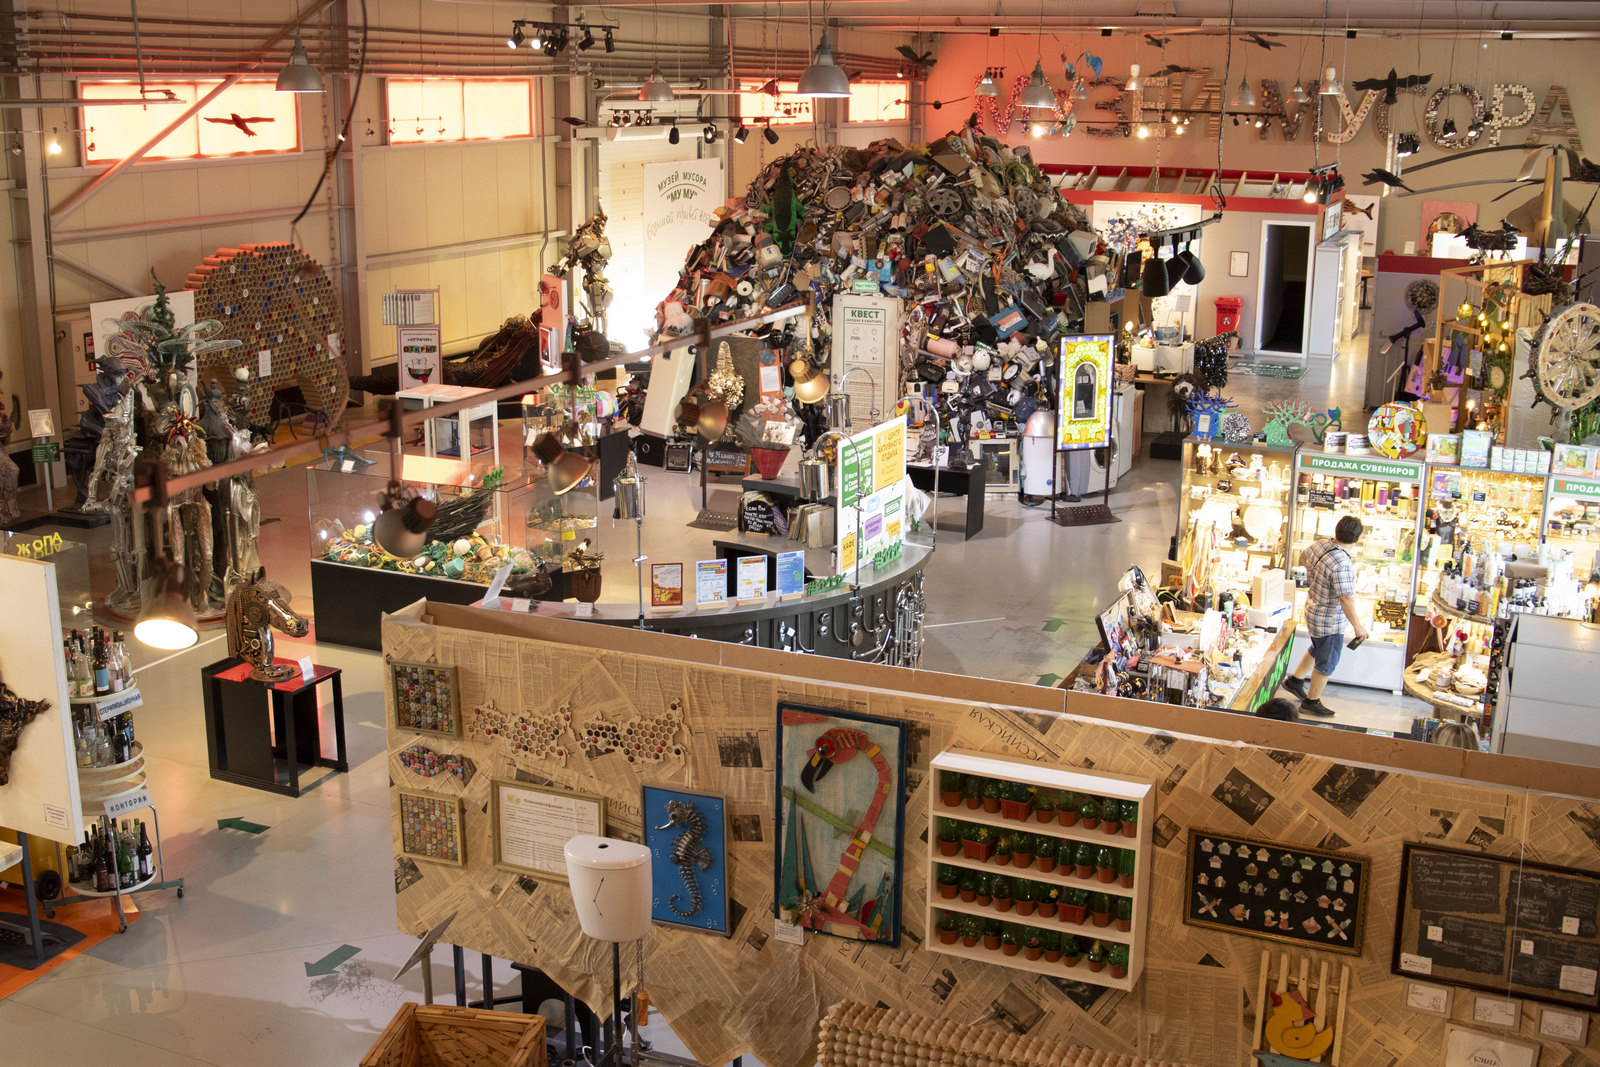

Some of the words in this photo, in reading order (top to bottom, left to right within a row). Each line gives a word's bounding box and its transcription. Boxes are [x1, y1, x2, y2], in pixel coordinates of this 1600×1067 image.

[1260, 78, 1584, 152] МУСОРА
[658, 170, 680, 192] МУЗЕЙ
[682, 171, 707, 188] МУСОРА
[851, 309, 880, 319] КВЕСТ
[403, 345, 437, 353] ОТКРЫТ
[1312, 459, 1358, 470] ПРОДАЖА
[1360, 463, 1415, 476] СУВЕНИРОВ
[16, 532, 63, 555] ЖОПА
[843, 539, 855, 550] КАФЕ
